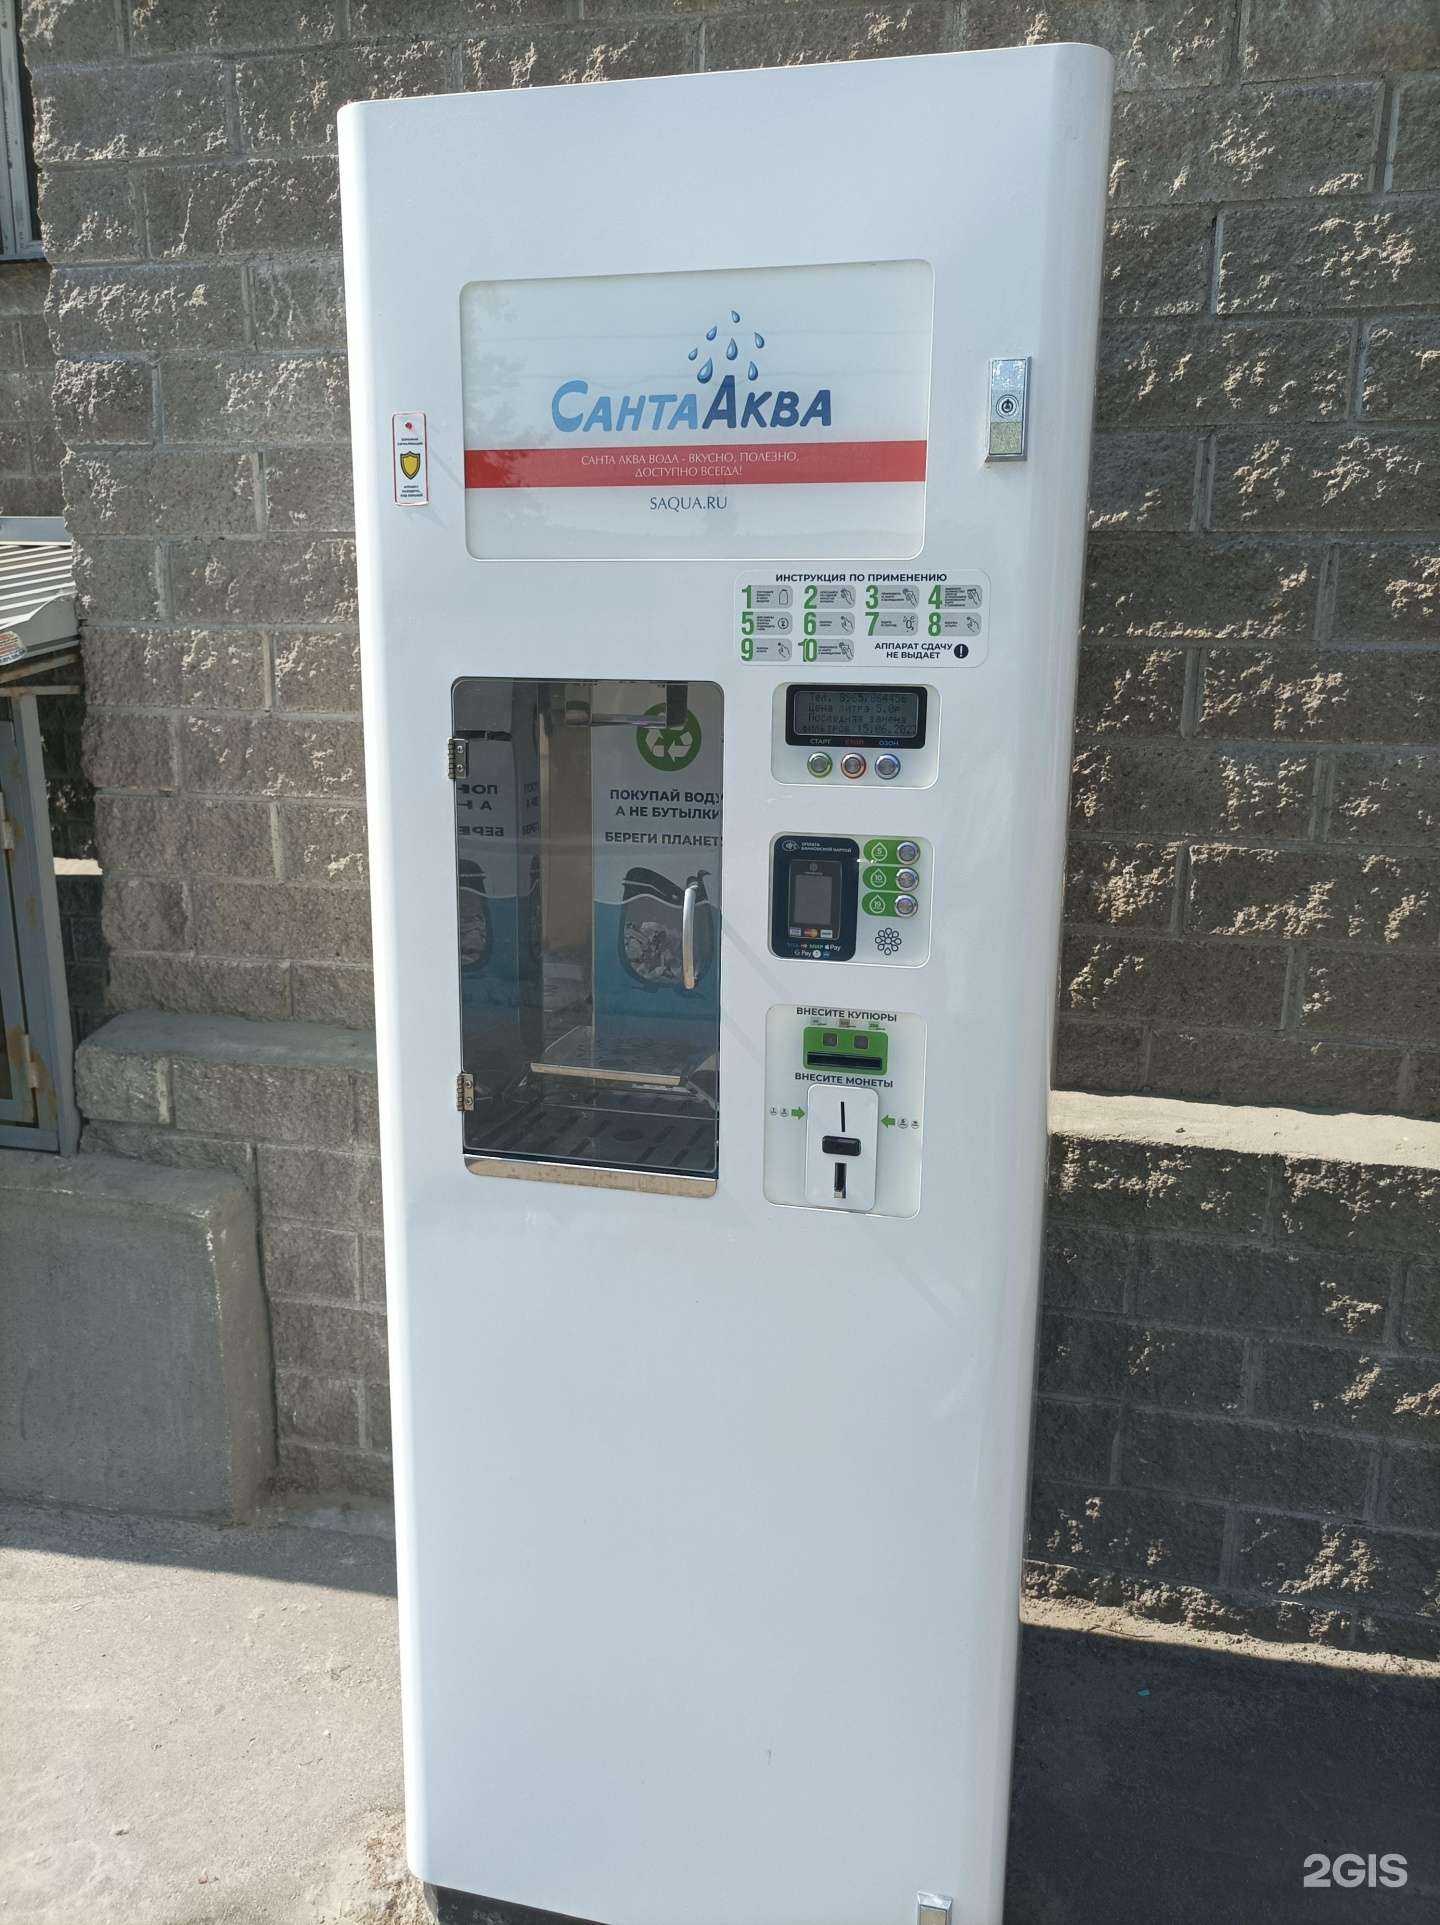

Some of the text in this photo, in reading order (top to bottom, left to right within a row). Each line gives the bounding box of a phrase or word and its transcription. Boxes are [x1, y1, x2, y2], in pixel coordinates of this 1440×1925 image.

[581, 455, 616, 466] САНТА
[619, 454, 646, 465] АКВА
[650, 454, 679, 465] ВОДА
[688, 452, 737, 464] ВКУСНО,
[634, 466, 743, 478] ДОСТУПНО ВСЕГДА!
[650, 496, 728, 512] SAQUA.RU
[775, 573, 947, 583] ИНСТРУКЦИЯ ПО ПРИМЕНЕНИЮ
[741, 585, 752, 609] 1
[804, 585, 818, 609] 2
[865, 585, 879, 609] 3
[928, 585, 942, 609] 4
[741, 611, 754, 636] 5
[803, 612, 817, 636] 6
[865, 612, 880, 636] 7
[928, 612, 942, 637] 8
[741, 638, 754, 661] 9
[798, 638, 818, 662] 10
[921, 643, 953, 651] СДАЧУ
[901, 652, 940, 660] ВЫДАЕТ
[610, 786, 681, 802] ПОКУПАЙ
[615, 805, 626, 817] А
[629, 806, 649, 817] НЕ
[605, 831, 658, 844] БЕРЕГИ
[796, 1007, 897, 1022] ВНЕСИТЕ КУПЮРЫ
[795, 1072, 893, 1088] ВНЕСИТЕ МОНЕТЫ
